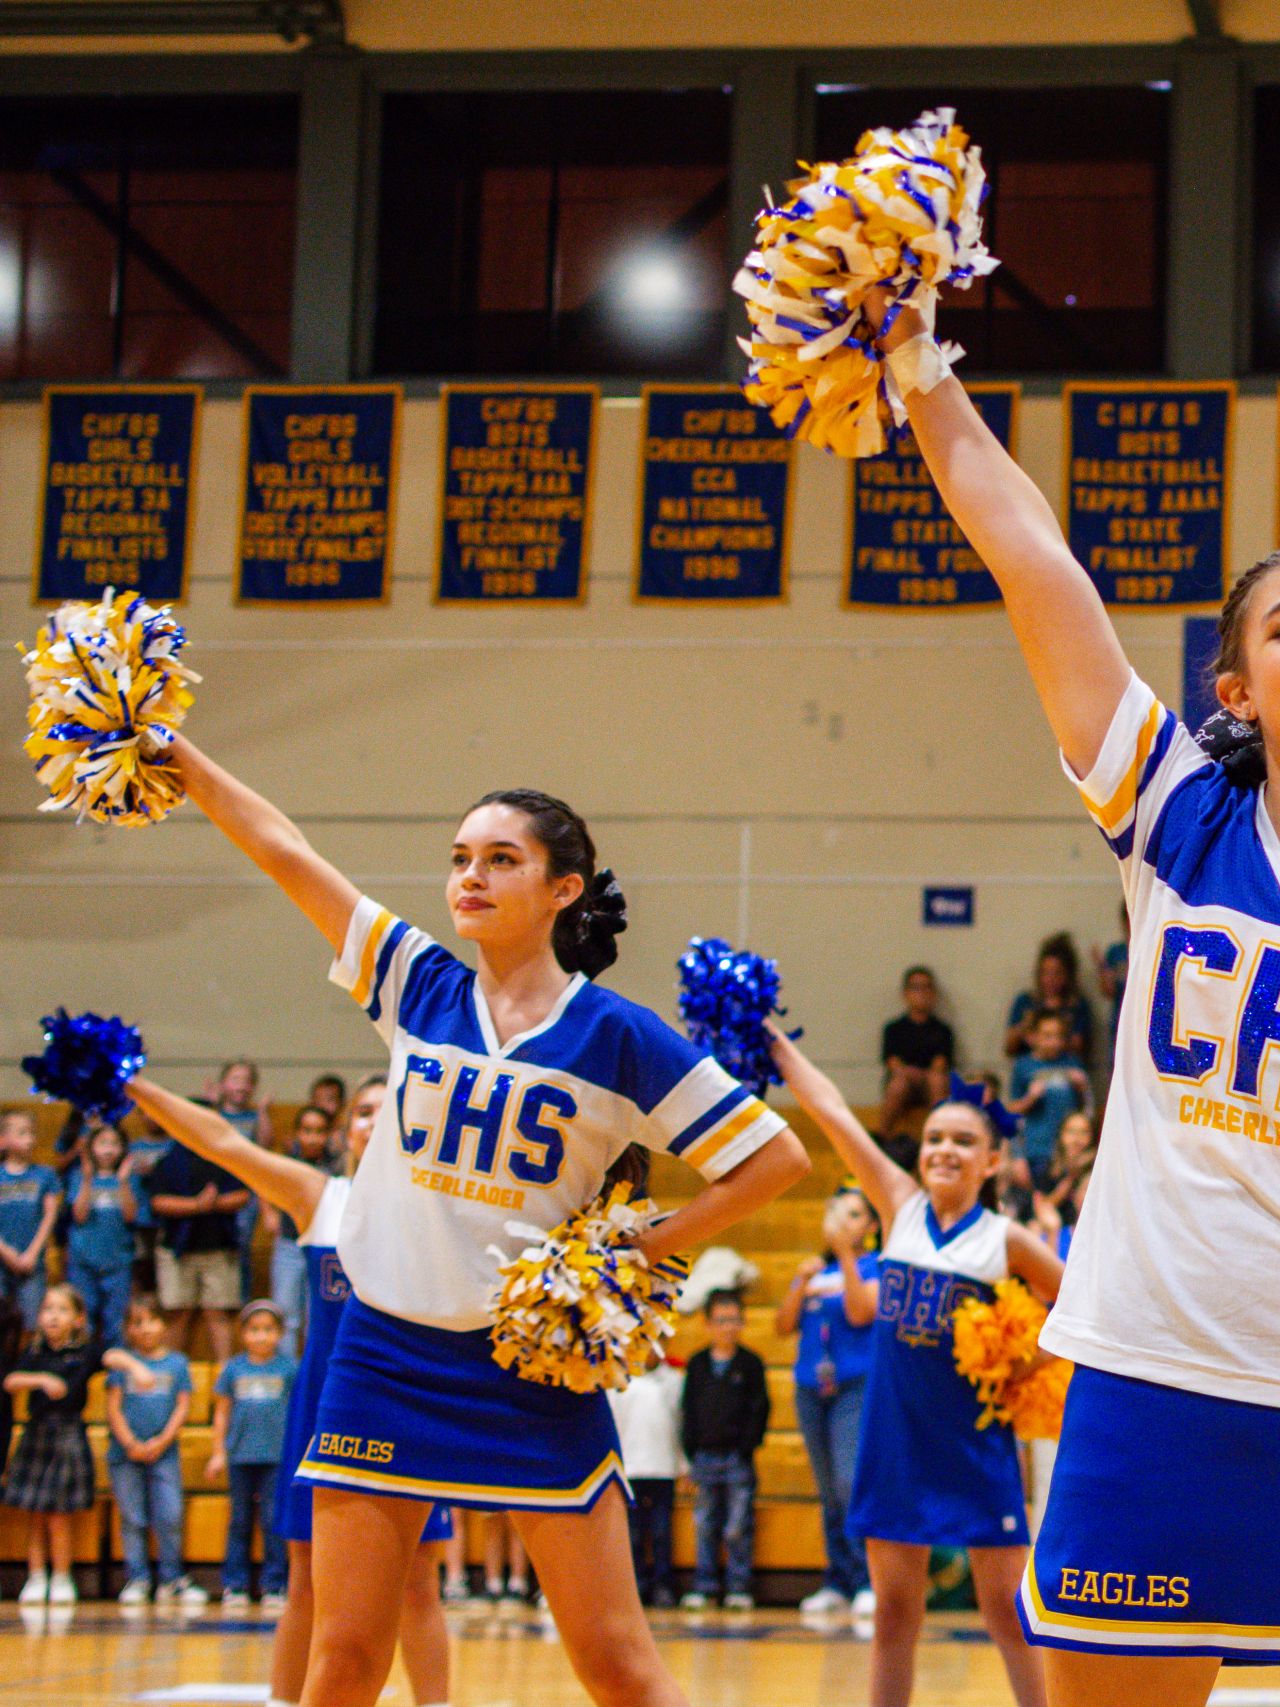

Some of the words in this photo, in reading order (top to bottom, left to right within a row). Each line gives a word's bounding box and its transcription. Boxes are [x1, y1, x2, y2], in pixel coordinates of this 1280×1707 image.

[487, 423, 549, 446] BOYS
[1118, 431, 1181, 455] BOYS
[87, 438, 153, 462] GIRLS
[288, 439, 352, 463] GIRLS
[450, 447, 582, 472] BASKETBALL
[50, 462, 184, 487] BASKETBALL
[253, 463, 384, 486] VOLLEYBALL
[458, 472, 526, 495] TAPPS
[1073, 458, 1221, 484] BASKETBALL
[63, 488, 135, 511] TAPPS
[261, 487, 328, 512] TAPPS
[658, 497, 768, 521] NATIONAL
[859, 489, 932, 515] TAPPS
[1073, 487, 1147, 513] TAPPS
[60, 512, 166, 536] REGIONAL
[1109, 517, 1183, 542] STATE
[649, 524, 774, 550] CHAMPIONS
[461, 546, 561, 571] FINALIST
[858, 547, 925, 573] FINAL
[1090, 546, 1198, 571] FINALIST
[396, 1049, 579, 1190] CHS
[319, 1432, 395, 1464] EAGLES
[1058, 1567, 1191, 1609] EAGLES
